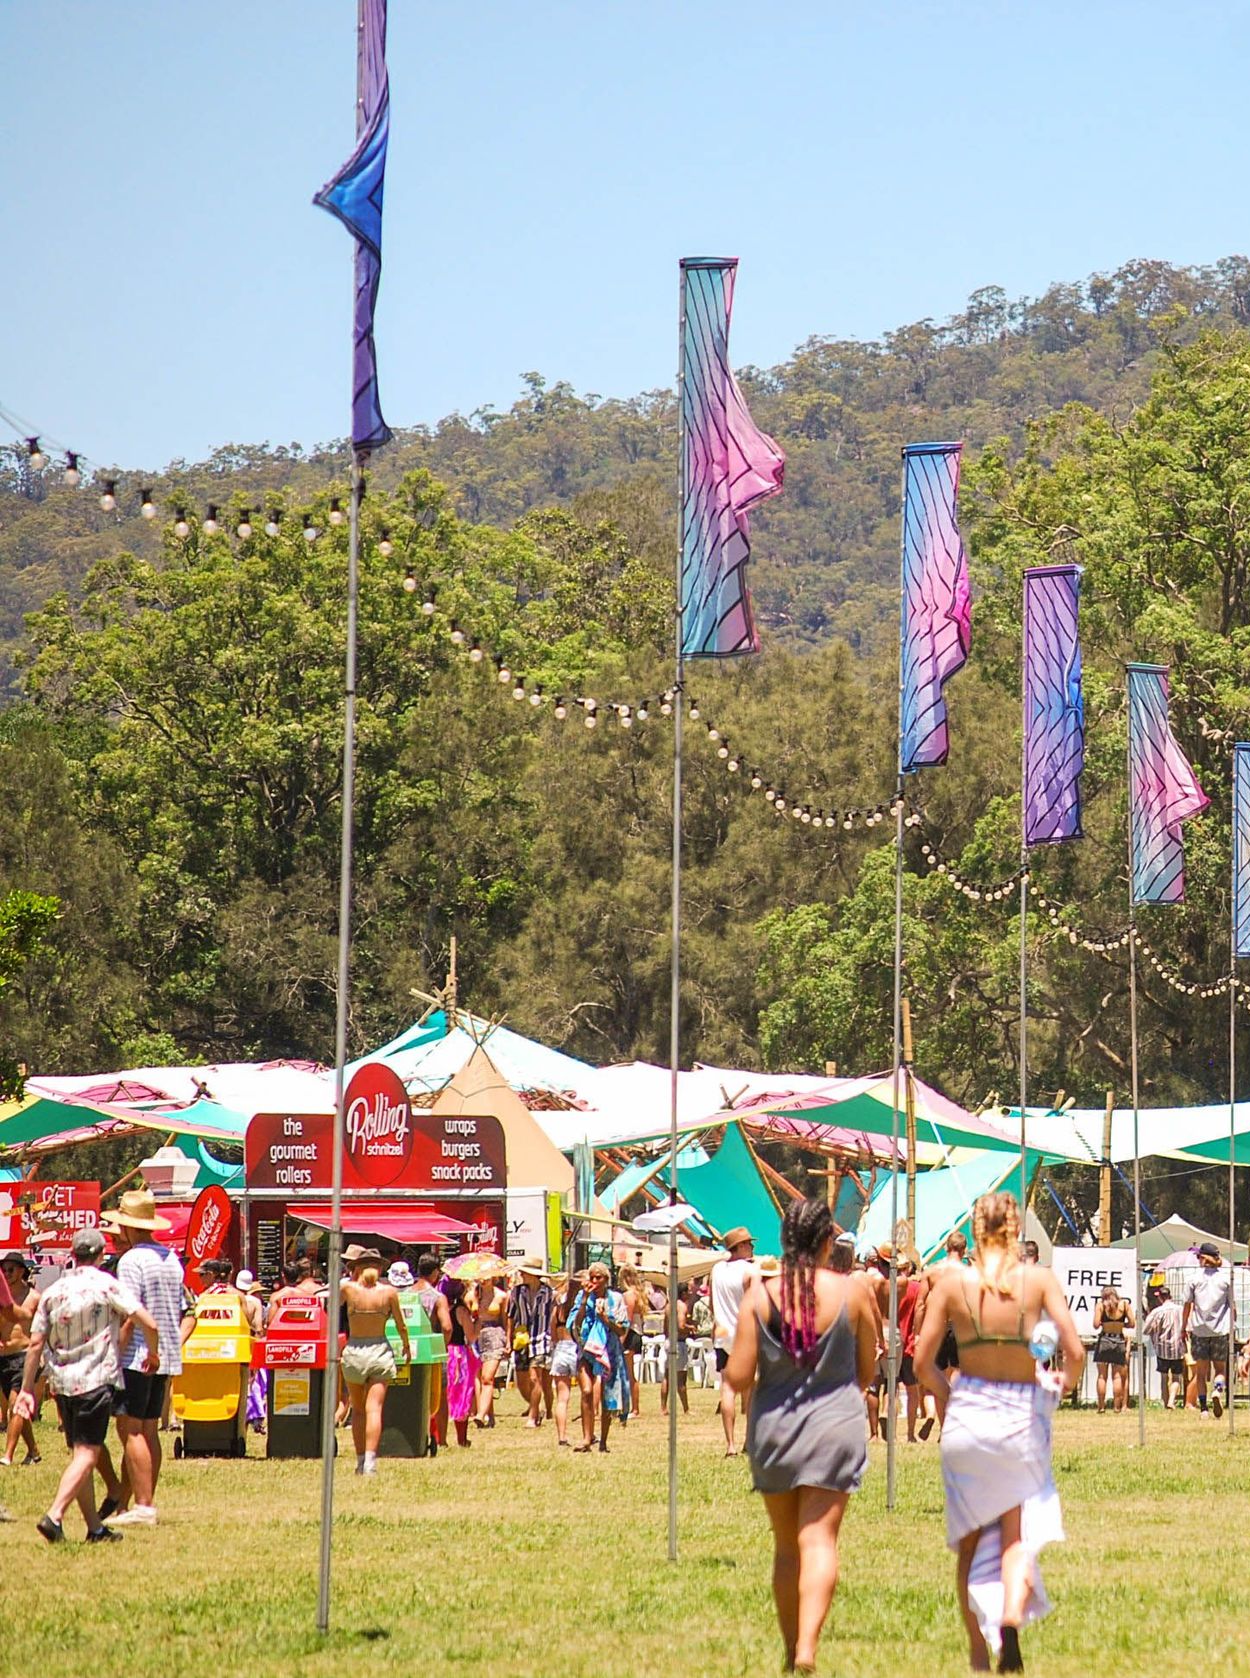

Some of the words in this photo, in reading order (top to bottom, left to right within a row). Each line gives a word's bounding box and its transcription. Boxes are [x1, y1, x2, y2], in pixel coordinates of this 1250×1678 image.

[283, 1118, 303, 1136] the
[346, 1092, 409, 1156] Rolling
[444, 1120, 477, 1137] wraps
[270, 1143, 318, 1164] gourmet
[366, 1141, 404, 1156] schnitzel
[441, 1139, 481, 1161] burgers
[276, 1165, 312, 1184] rollers
[431, 1163, 461, 1180] snack
[462, 1163, 493, 1183] packs
[42, 1186, 76, 1206] GET
[1068, 1269, 1122, 1287] FREE
[268, 1345, 293, 1353] LANDFILL
